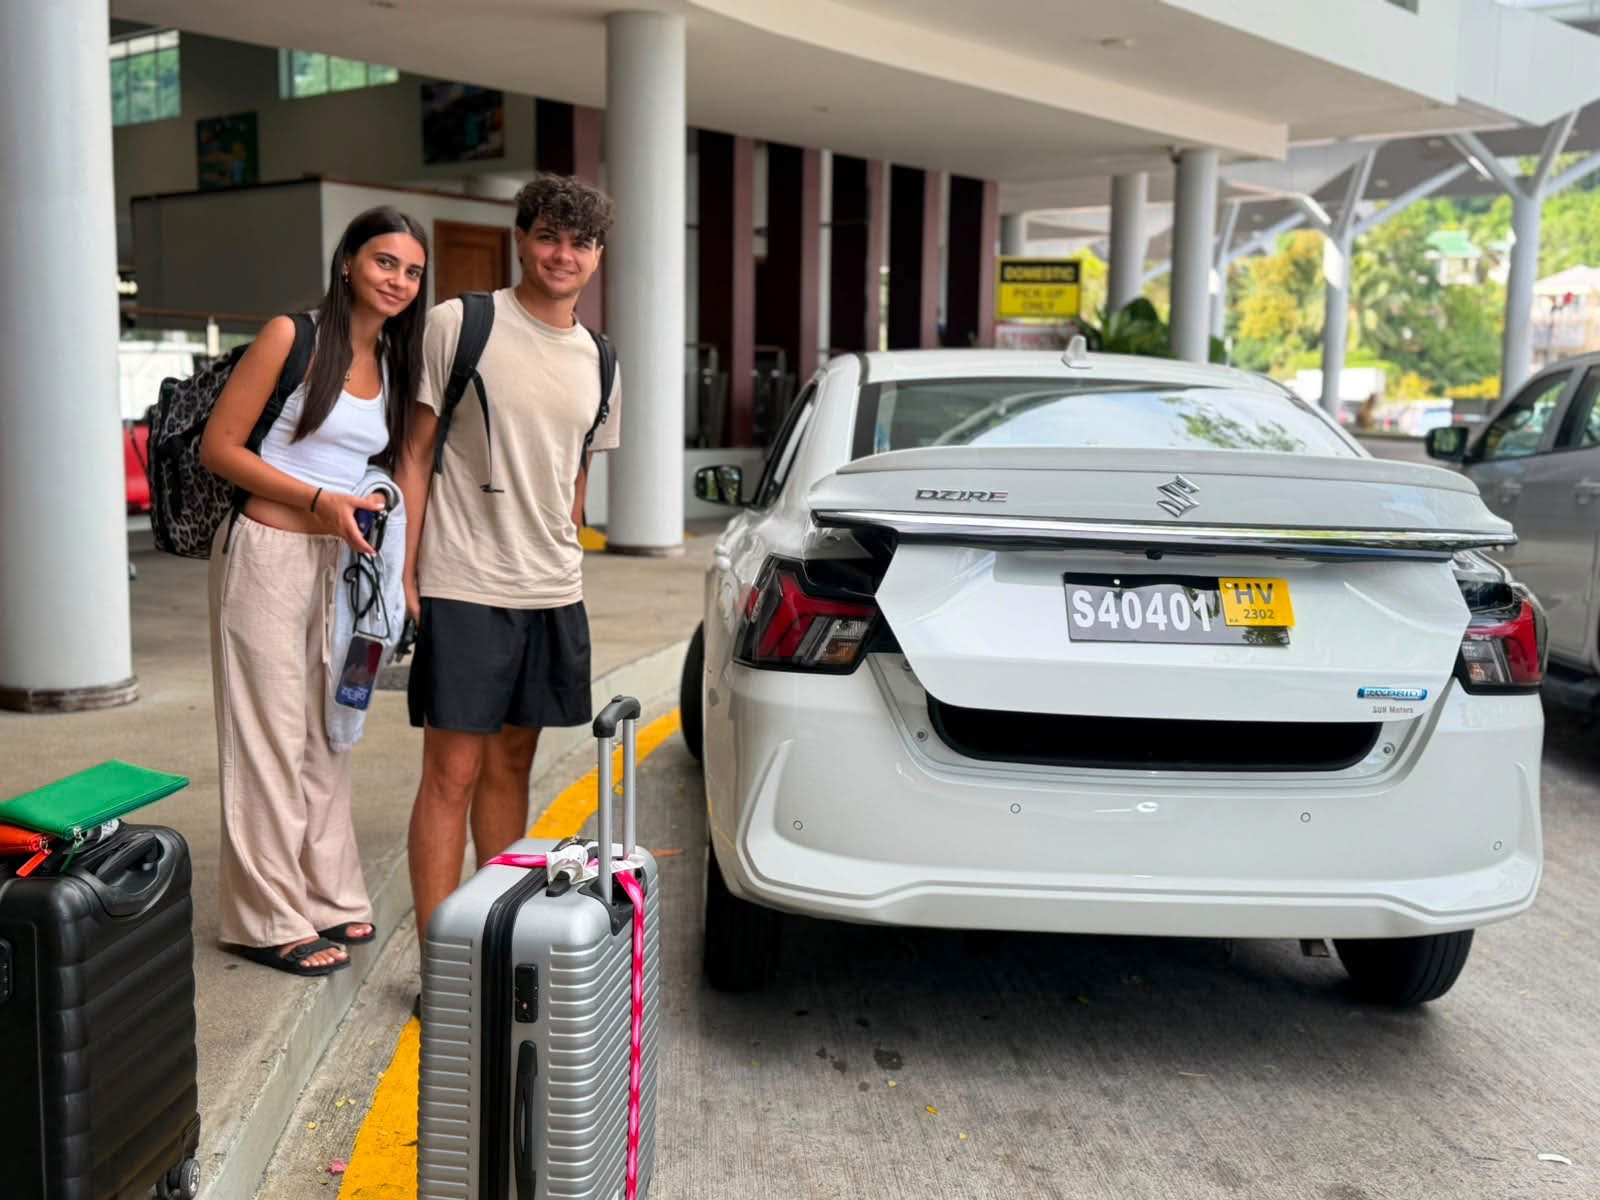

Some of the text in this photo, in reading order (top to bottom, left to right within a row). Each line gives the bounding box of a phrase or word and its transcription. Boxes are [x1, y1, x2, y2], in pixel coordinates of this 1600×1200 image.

[915, 489, 1009, 503] DZIRE
[1234, 583, 1273, 604] HV
[1072, 590, 1212, 631] S40401
[1243, 609, 1275, 619] 2302
